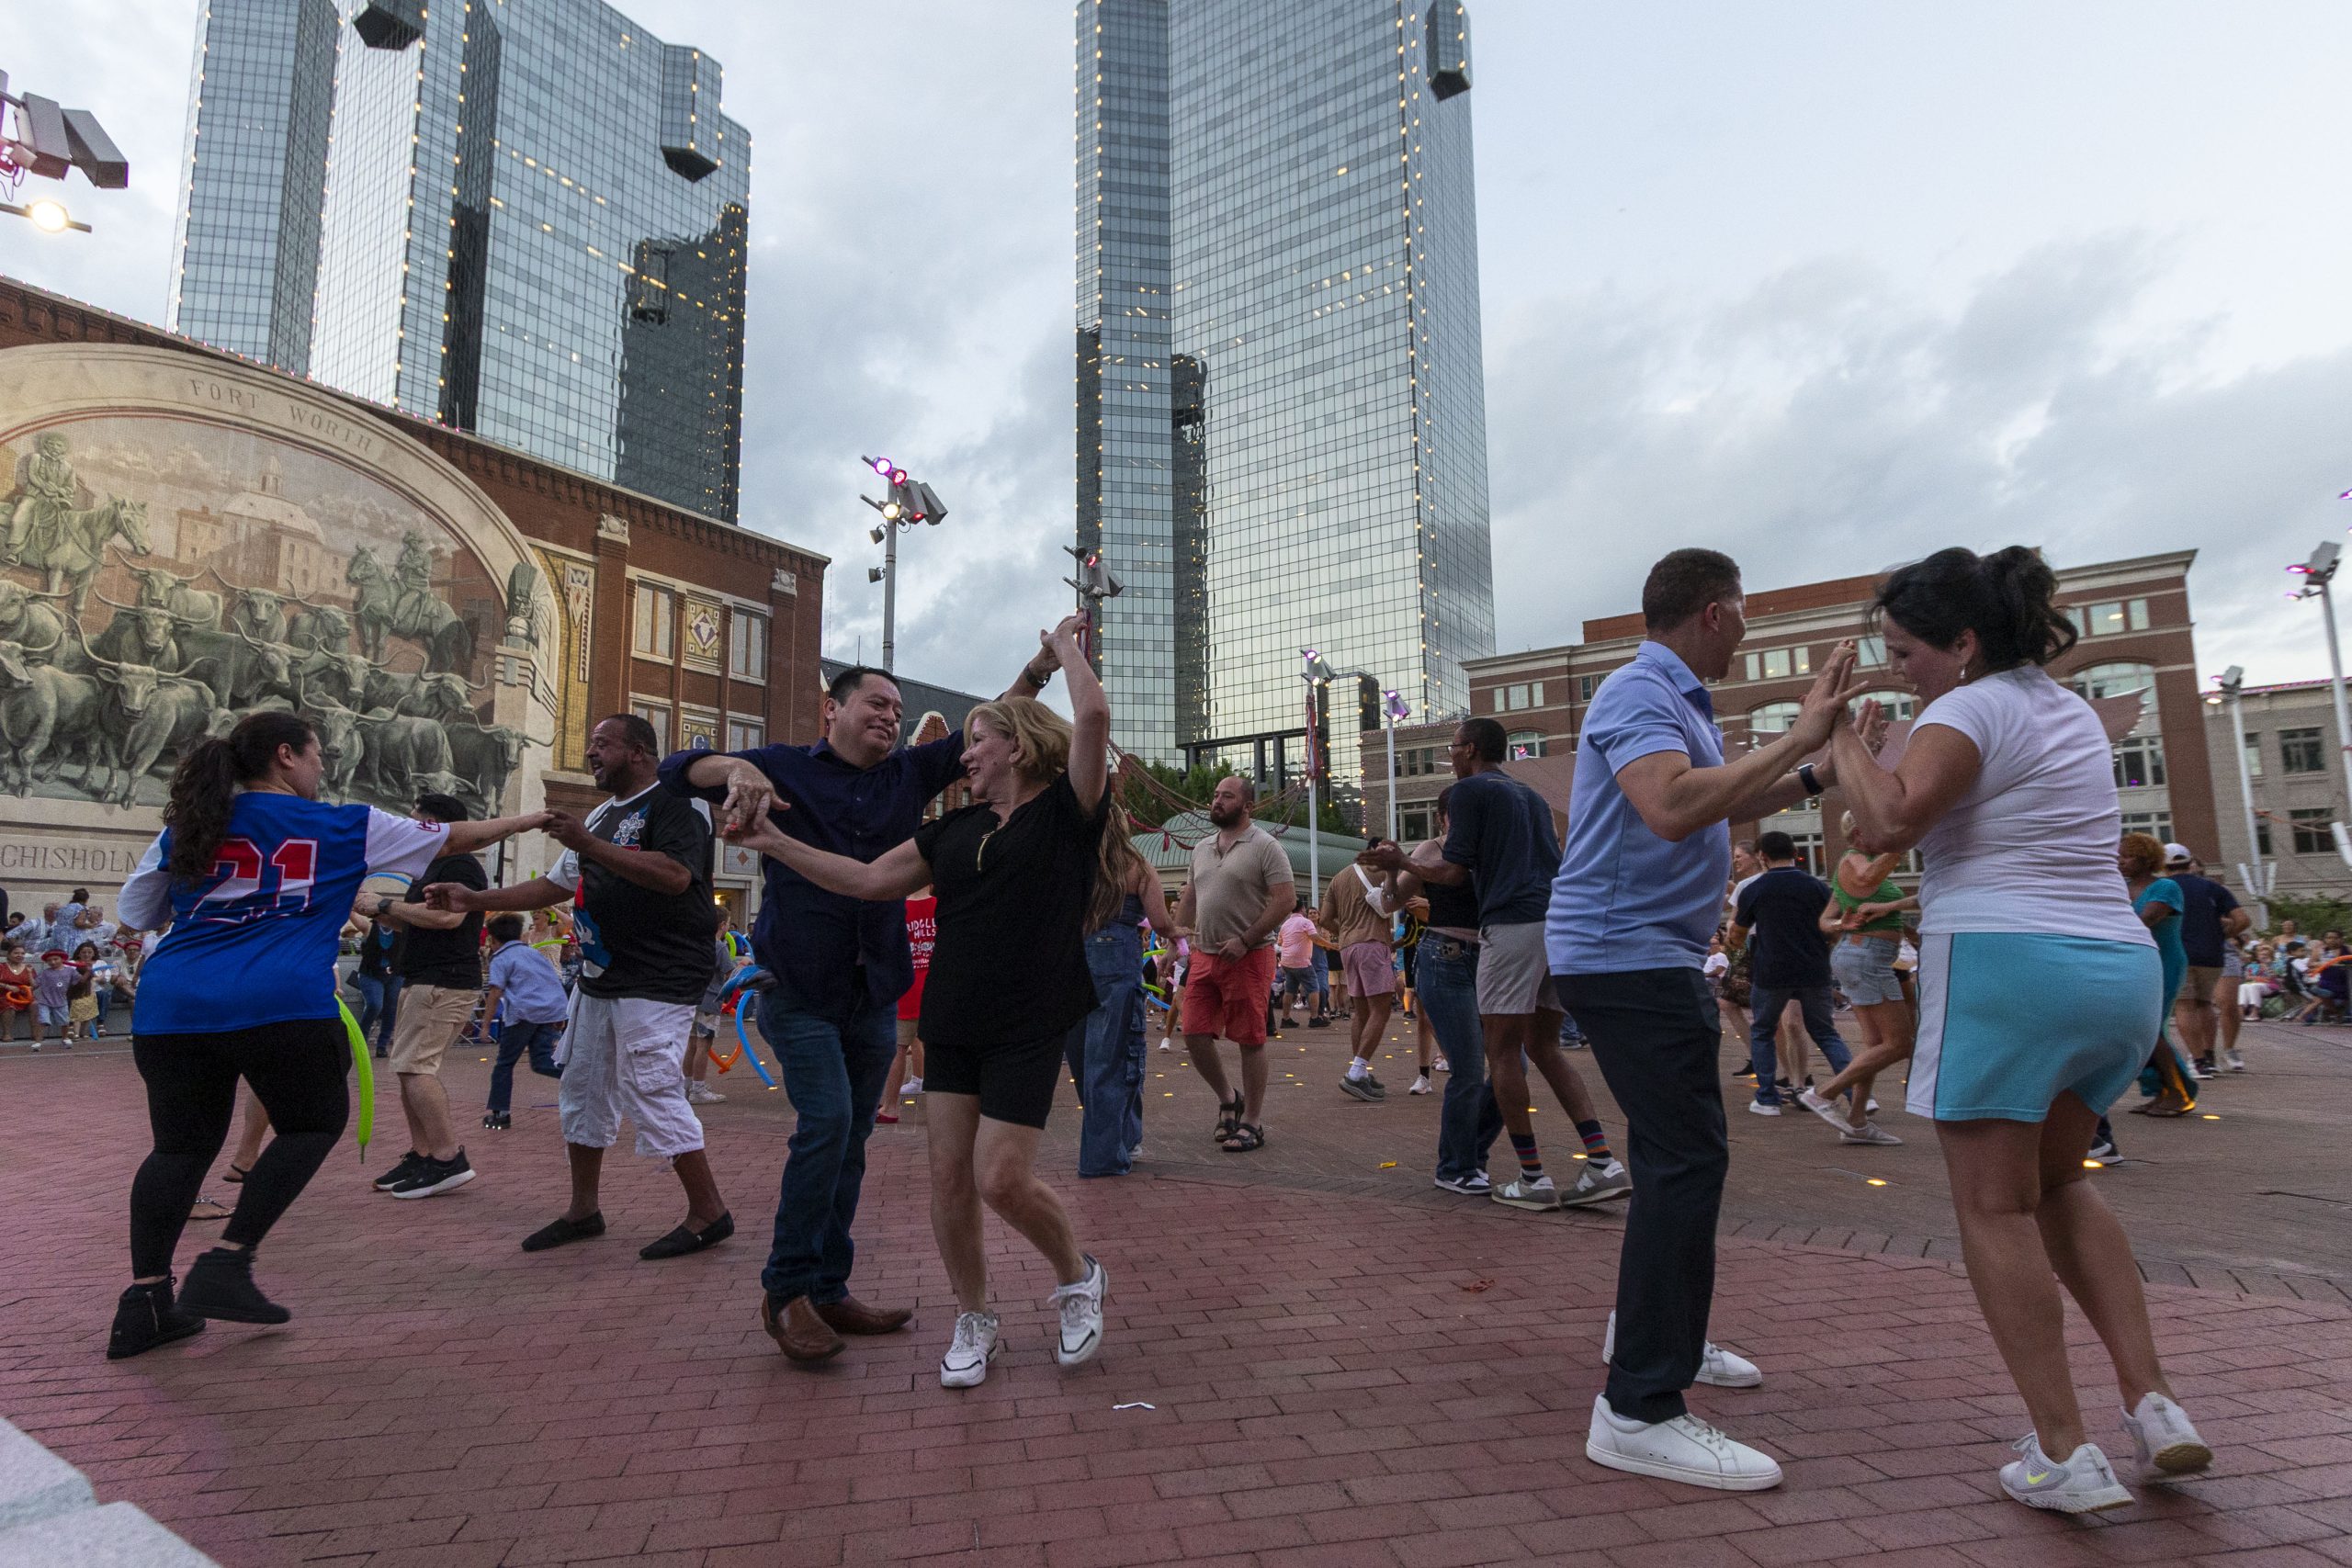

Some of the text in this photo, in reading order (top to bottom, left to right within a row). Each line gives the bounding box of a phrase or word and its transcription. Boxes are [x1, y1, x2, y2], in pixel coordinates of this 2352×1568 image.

[190, 378, 372, 452] FORT WORTH
[188, 837, 318, 924] 21
